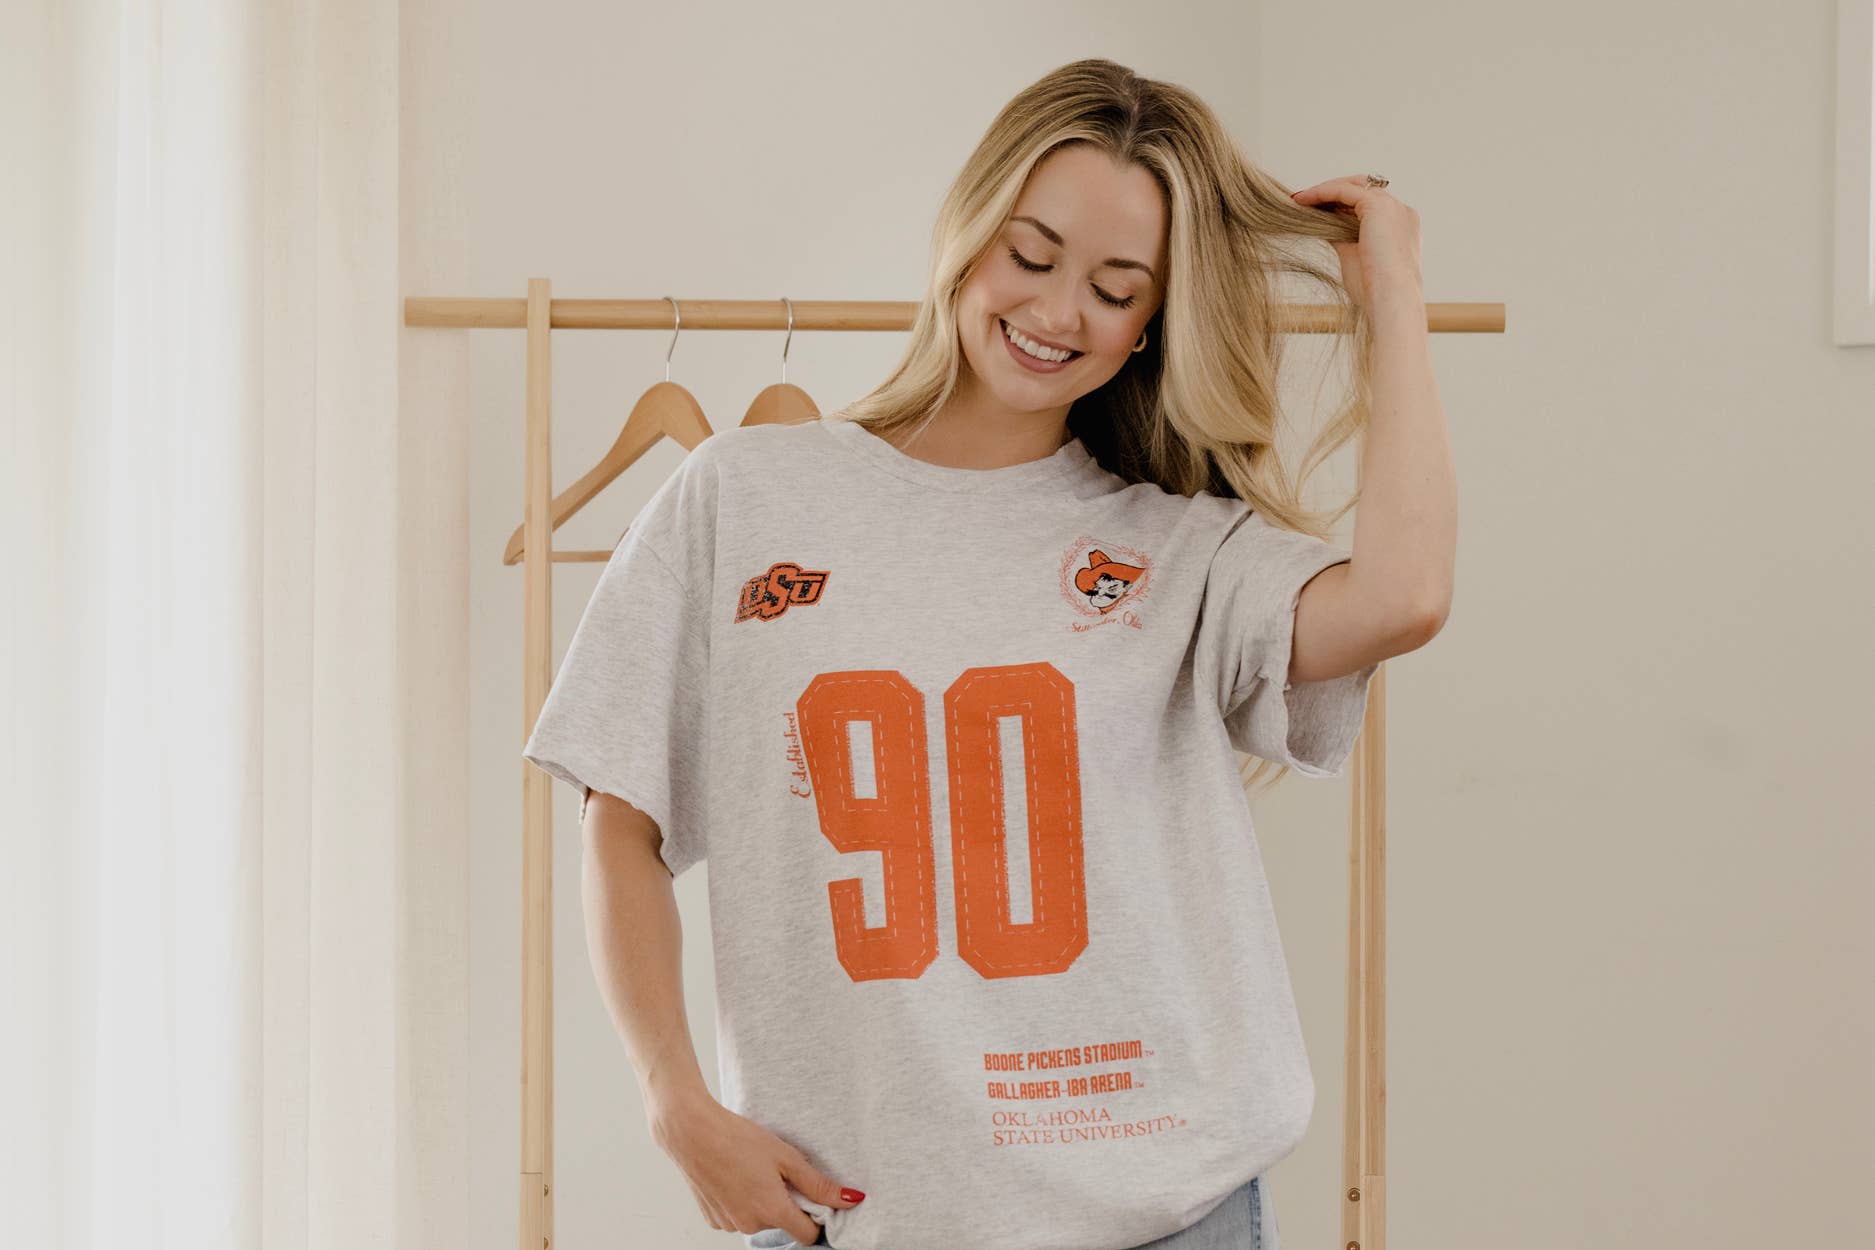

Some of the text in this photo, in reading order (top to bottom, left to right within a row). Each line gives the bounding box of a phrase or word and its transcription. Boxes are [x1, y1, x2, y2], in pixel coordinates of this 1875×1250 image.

[734, 562, 831, 624] OSU
[783, 712, 811, 798] Established
[796, 662, 1089, 982] 90
[984, 1053, 1025, 1071] BOONE
[1027, 1047, 1081, 1070] PICKENS
[988, 1078, 1088, 1100] GALLAGHER-IBA
[1090, 1071, 1132, 1094] ARENA
[992, 1107, 1112, 1127] OKLAHOMA
[993, 1129, 1054, 1146] STATE
